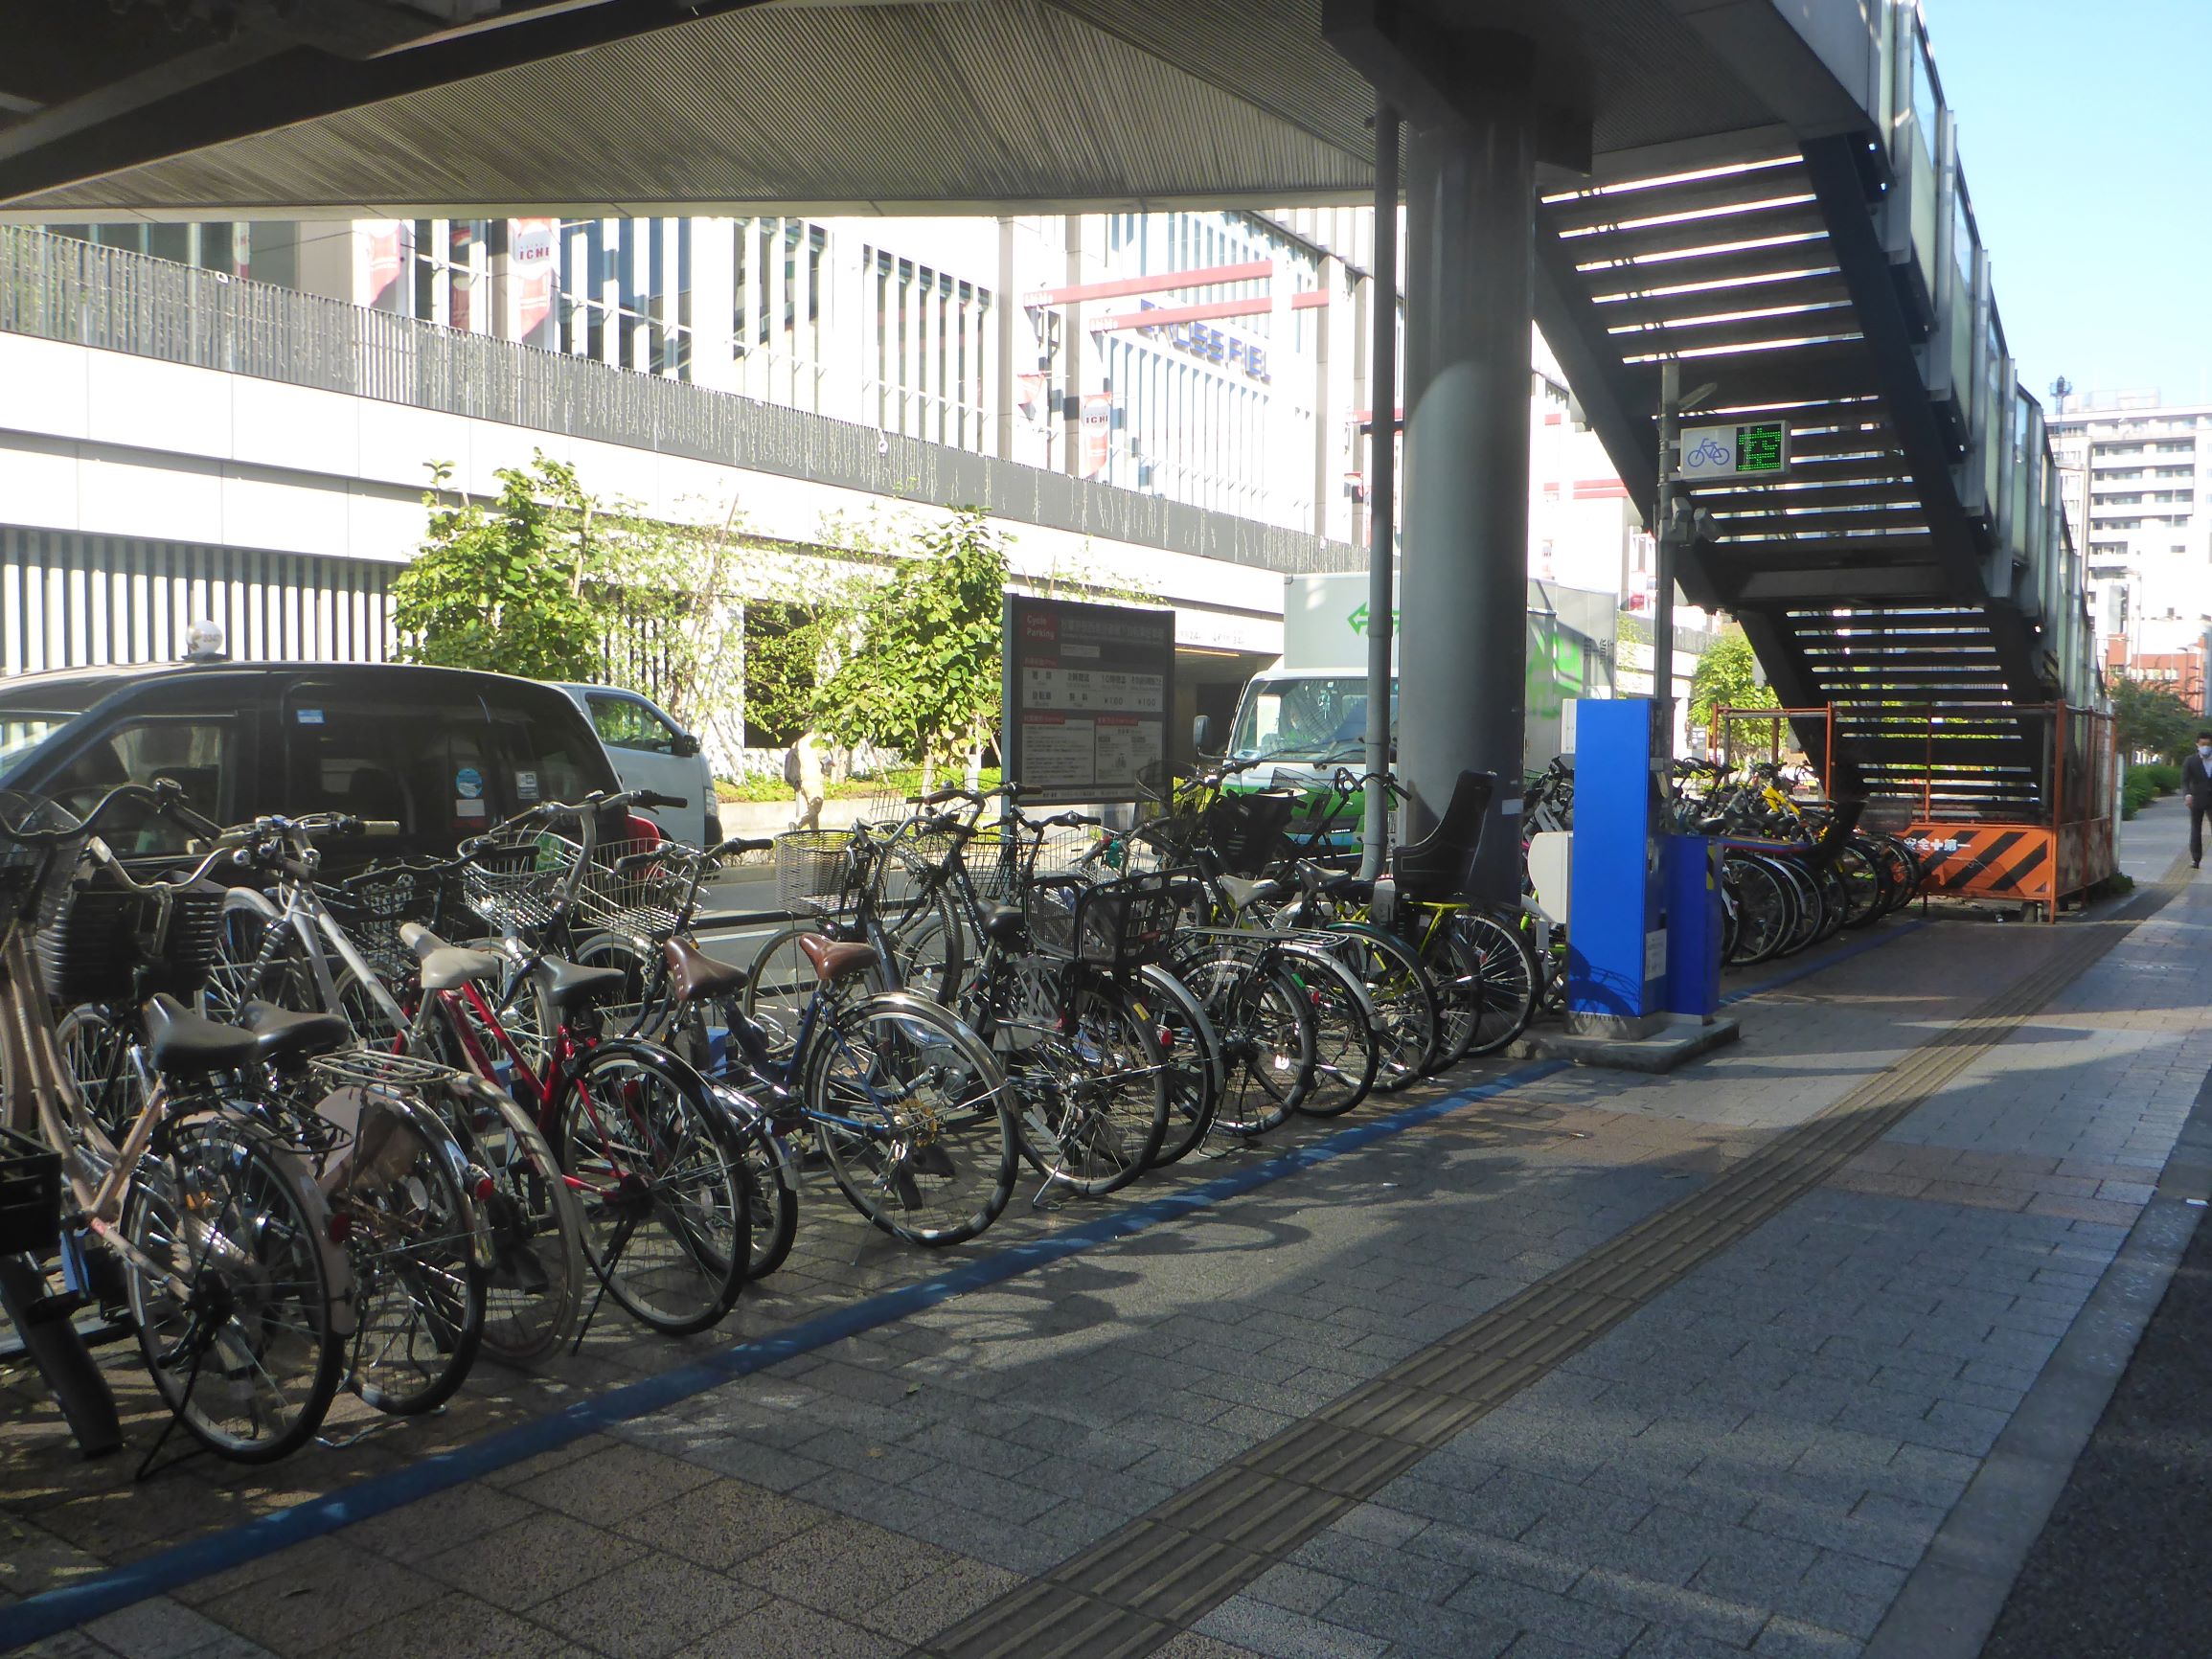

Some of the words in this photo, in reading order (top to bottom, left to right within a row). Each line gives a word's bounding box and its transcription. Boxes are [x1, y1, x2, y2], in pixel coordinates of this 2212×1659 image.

[519, 246, 550, 261] ICHI
[1085, 415, 1108, 423] ICHI
[1738, 427, 1781, 470] 空
[1026, 614, 1047, 626] Cycle
[1026, 627, 1056, 641] Parking
